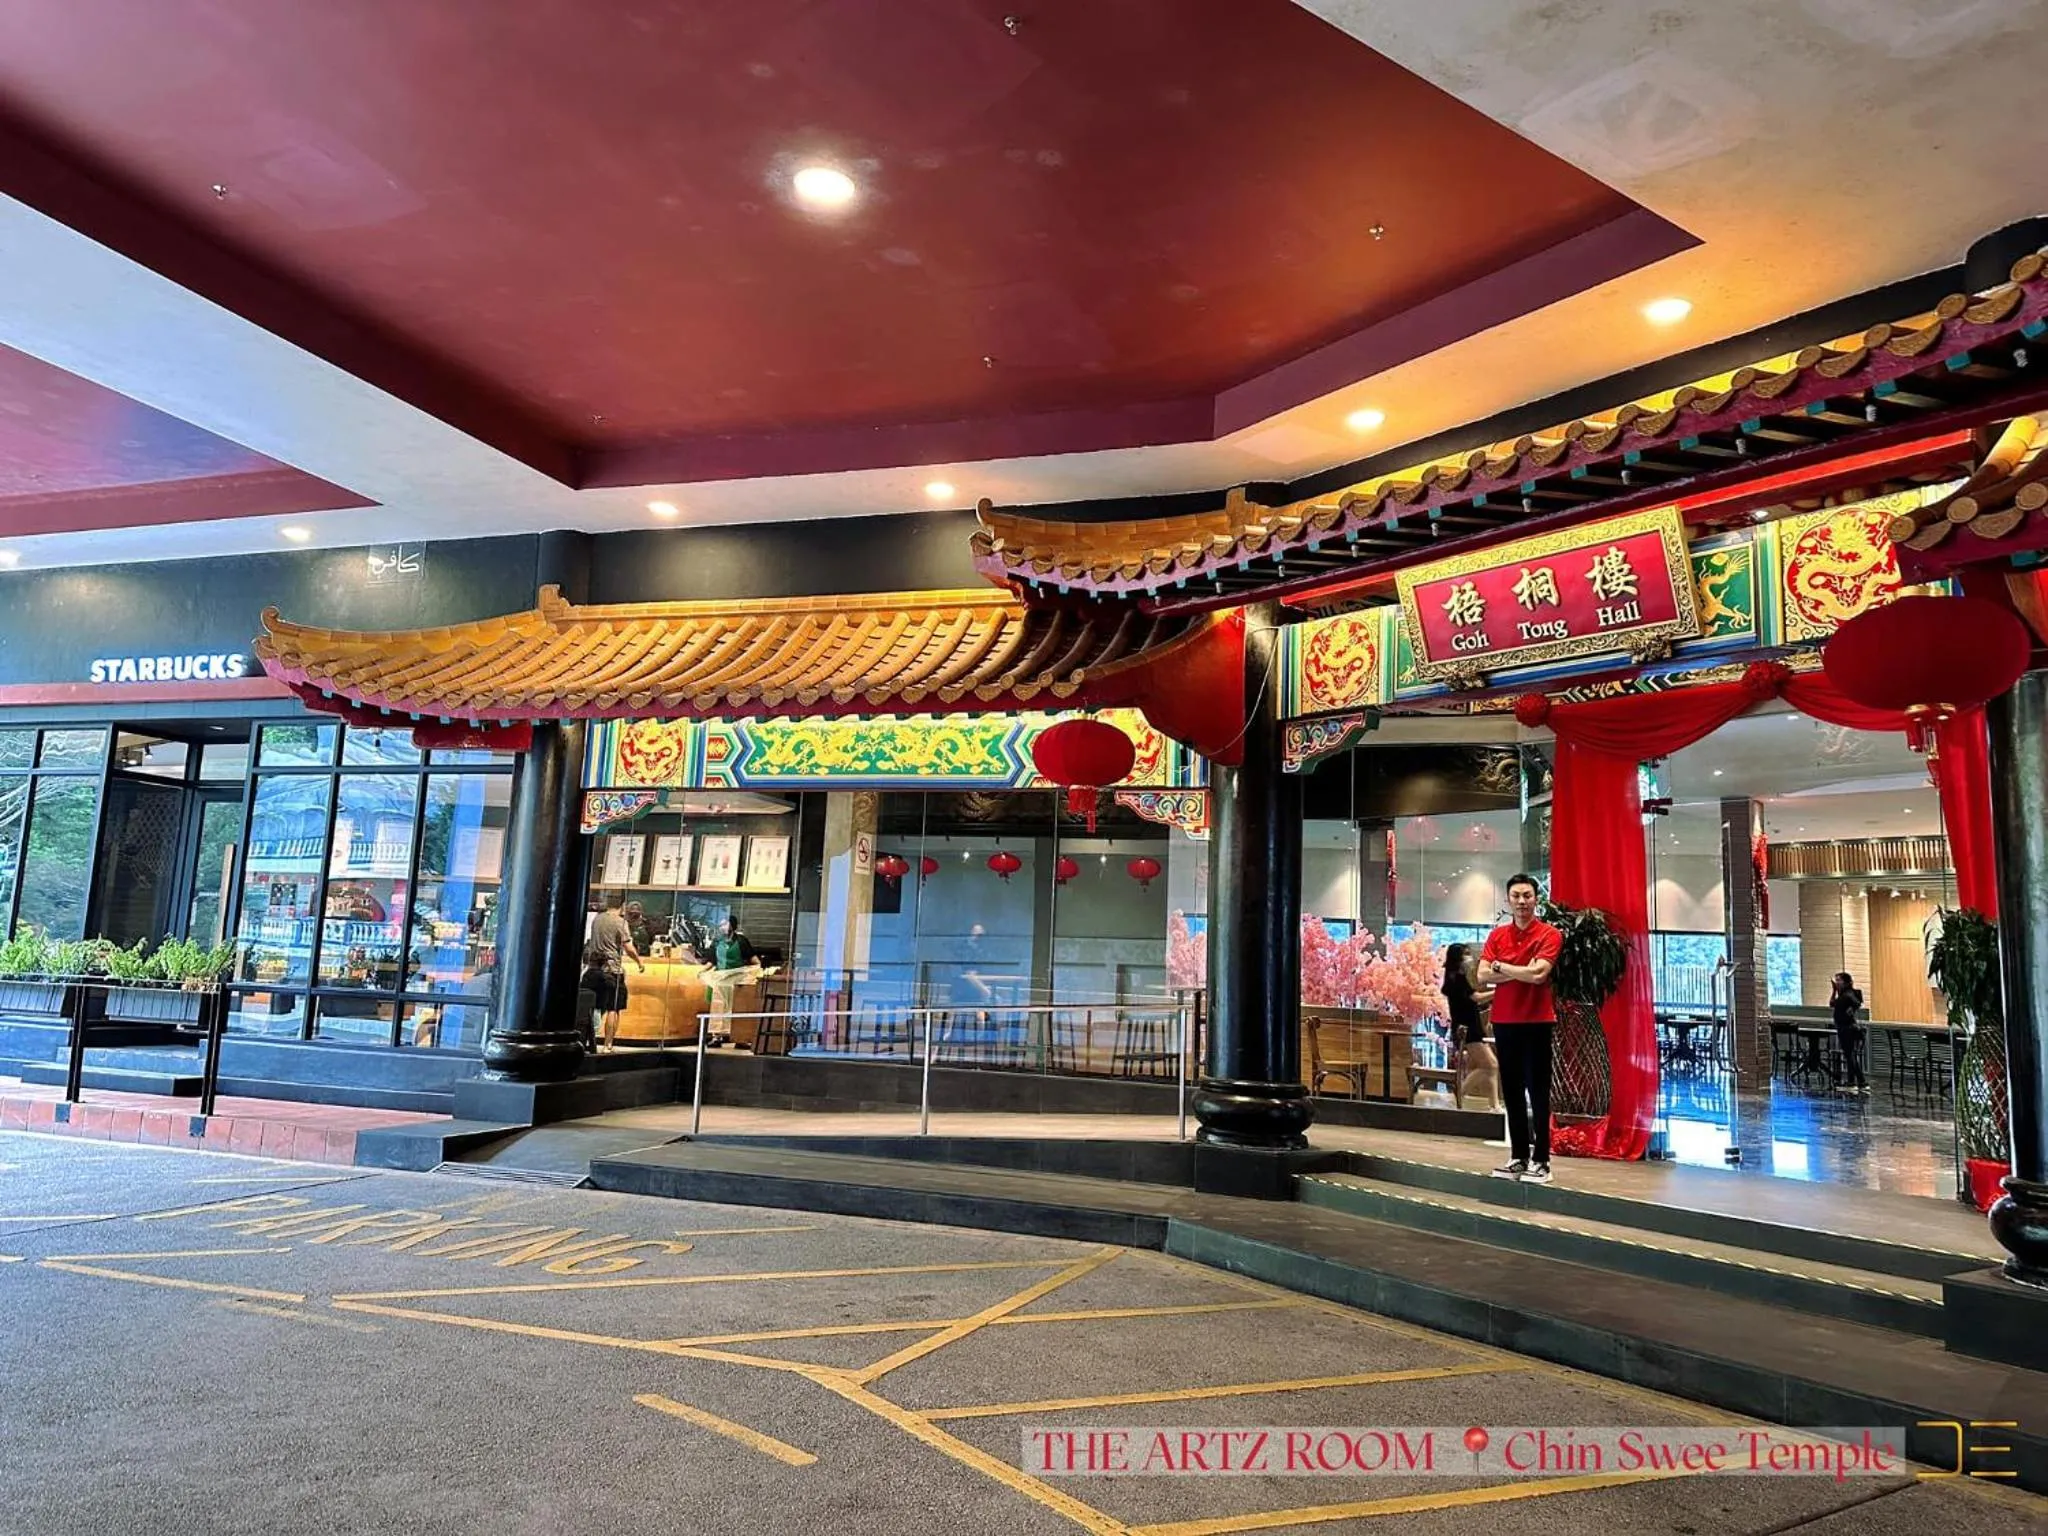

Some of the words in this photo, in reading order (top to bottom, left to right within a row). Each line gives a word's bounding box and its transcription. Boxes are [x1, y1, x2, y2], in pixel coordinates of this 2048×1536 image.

[1442, 546, 1639, 626] 梧桐樓
[1451, 630, 1489, 652] Goh
[1517, 619, 1568, 639] Tong
[1596, 601, 1641, 627] Hall
[90, 653, 245, 683] STARBUCKS
[132, 1194, 694, 1275] PARKING
